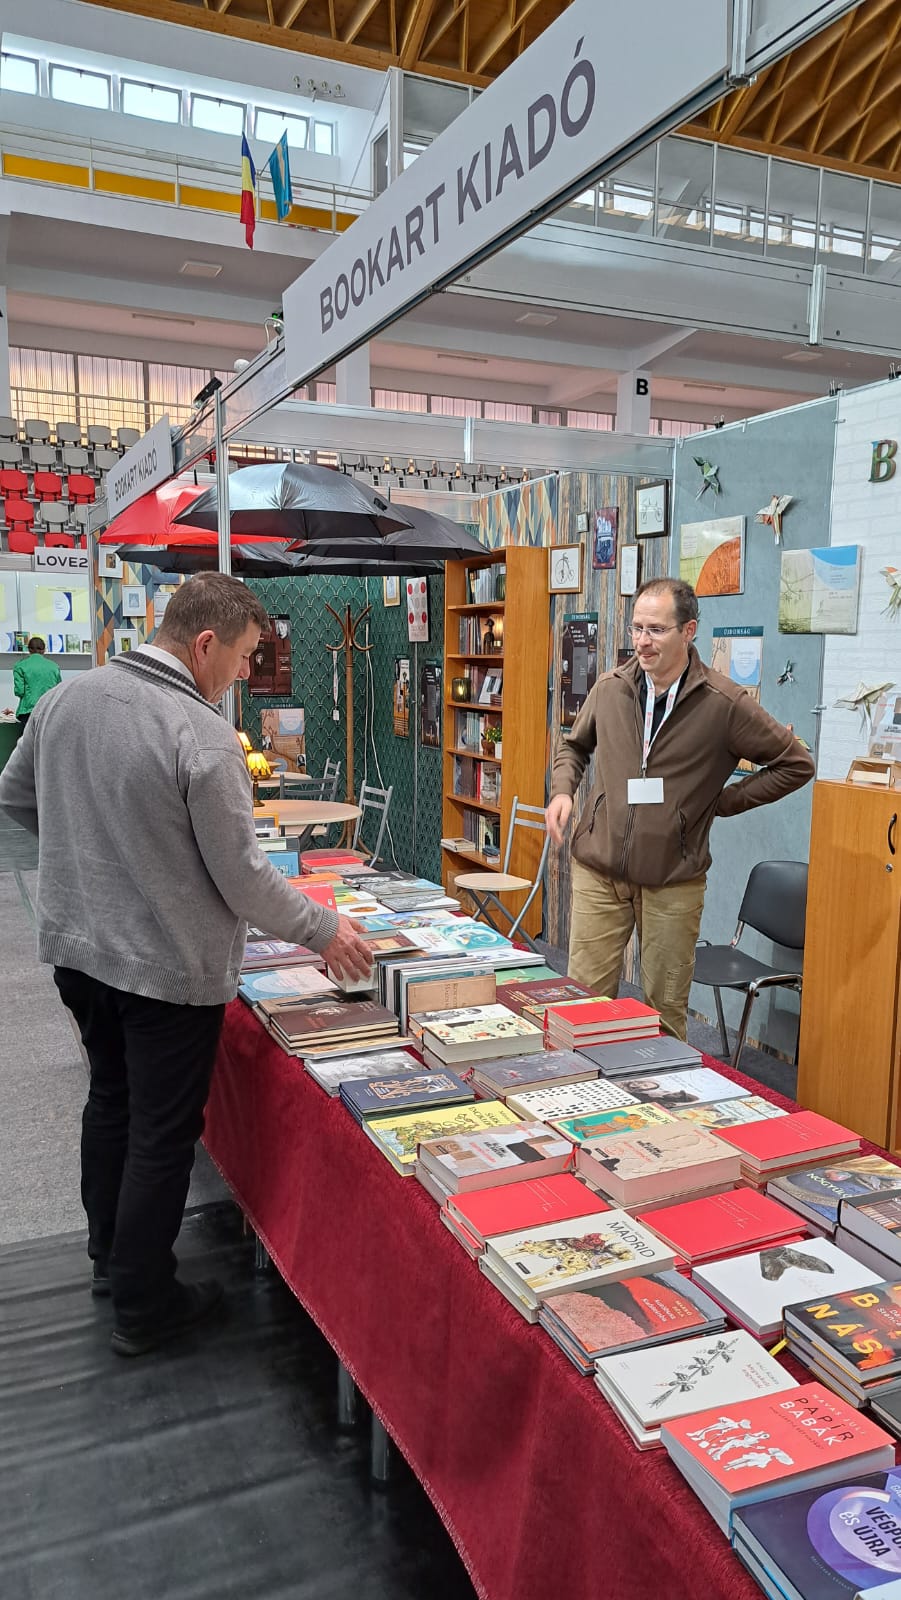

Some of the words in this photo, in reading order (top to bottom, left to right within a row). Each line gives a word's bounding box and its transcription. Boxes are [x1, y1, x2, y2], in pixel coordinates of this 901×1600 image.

[319, 182, 446, 335] BOOKART
[456, 35, 597, 226] KIADÓ
[636, 378, 649, 396] B
[114, 464, 138, 502] BOOKART
[137, 440, 158, 481] KIADÓ
[868, 439, 898, 483] B
[36, 555, 89, 568] LOVE2
[606, 1221, 656, 1258] MADRID
[779, 1401, 842, 1446] BABÁK
[794, 1397, 854, 1441] PAPÍR
[839, 1511, 861, 1526] és
[853, 1525, 892, 1558] ÚJRA
